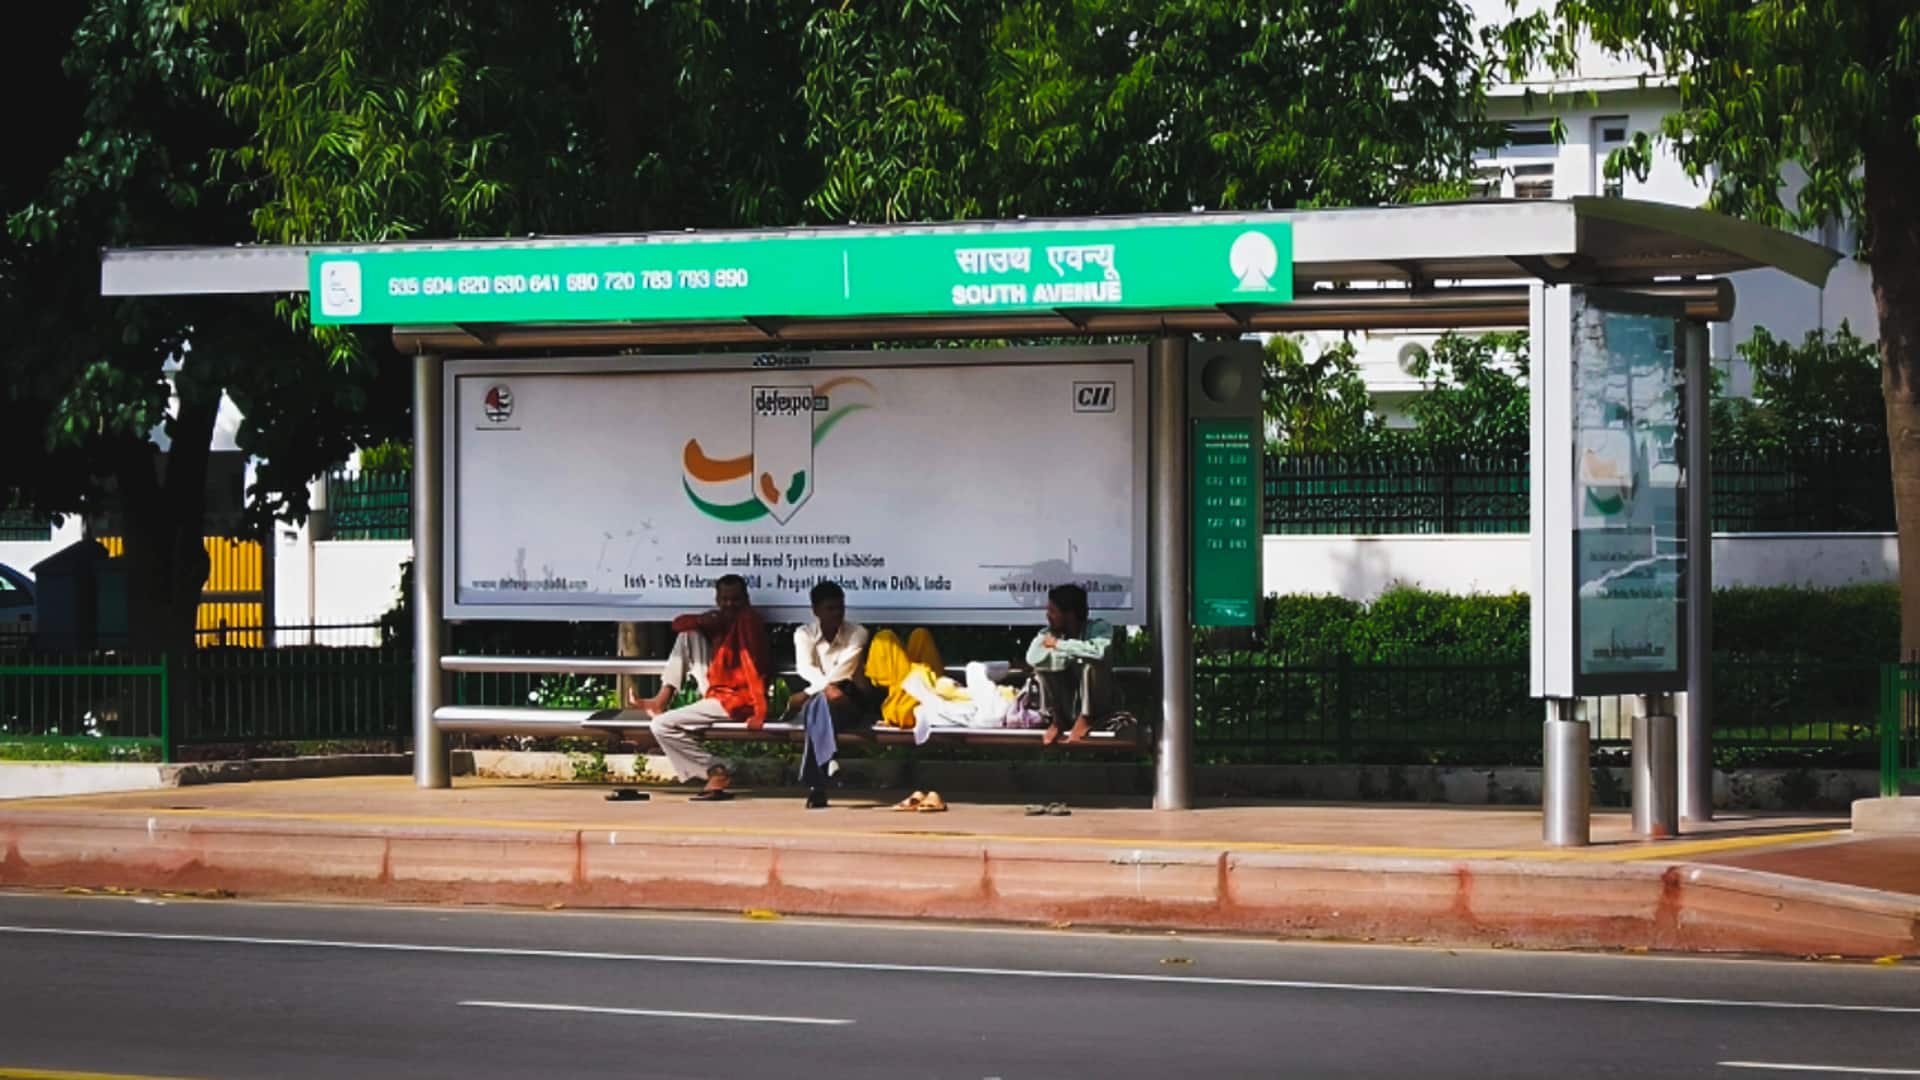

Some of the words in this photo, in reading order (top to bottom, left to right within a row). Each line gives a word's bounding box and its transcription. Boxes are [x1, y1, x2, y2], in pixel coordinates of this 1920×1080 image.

[954, 247, 1032, 275] साउथ
[1046, 244, 1121, 281] एवन्यू
[423, 276, 453, 294] 604
[458, 275, 490, 293] 620
[494, 274, 526, 293] 630
[529, 274, 560, 292] 641
[604, 272, 635, 290] 720
[952, 284, 1027, 305] SOUTH
[1033, 281, 1122, 302] AVENUE
[1078, 387, 1111, 406] CII
[705, 552, 728, 567] Land
[731, 551, 750, 567] and
[786, 552, 830, 571] Systems
[833, 551, 886, 568] Exhibition
[862, 575, 887, 590] New
[924, 573, 952, 590] India
